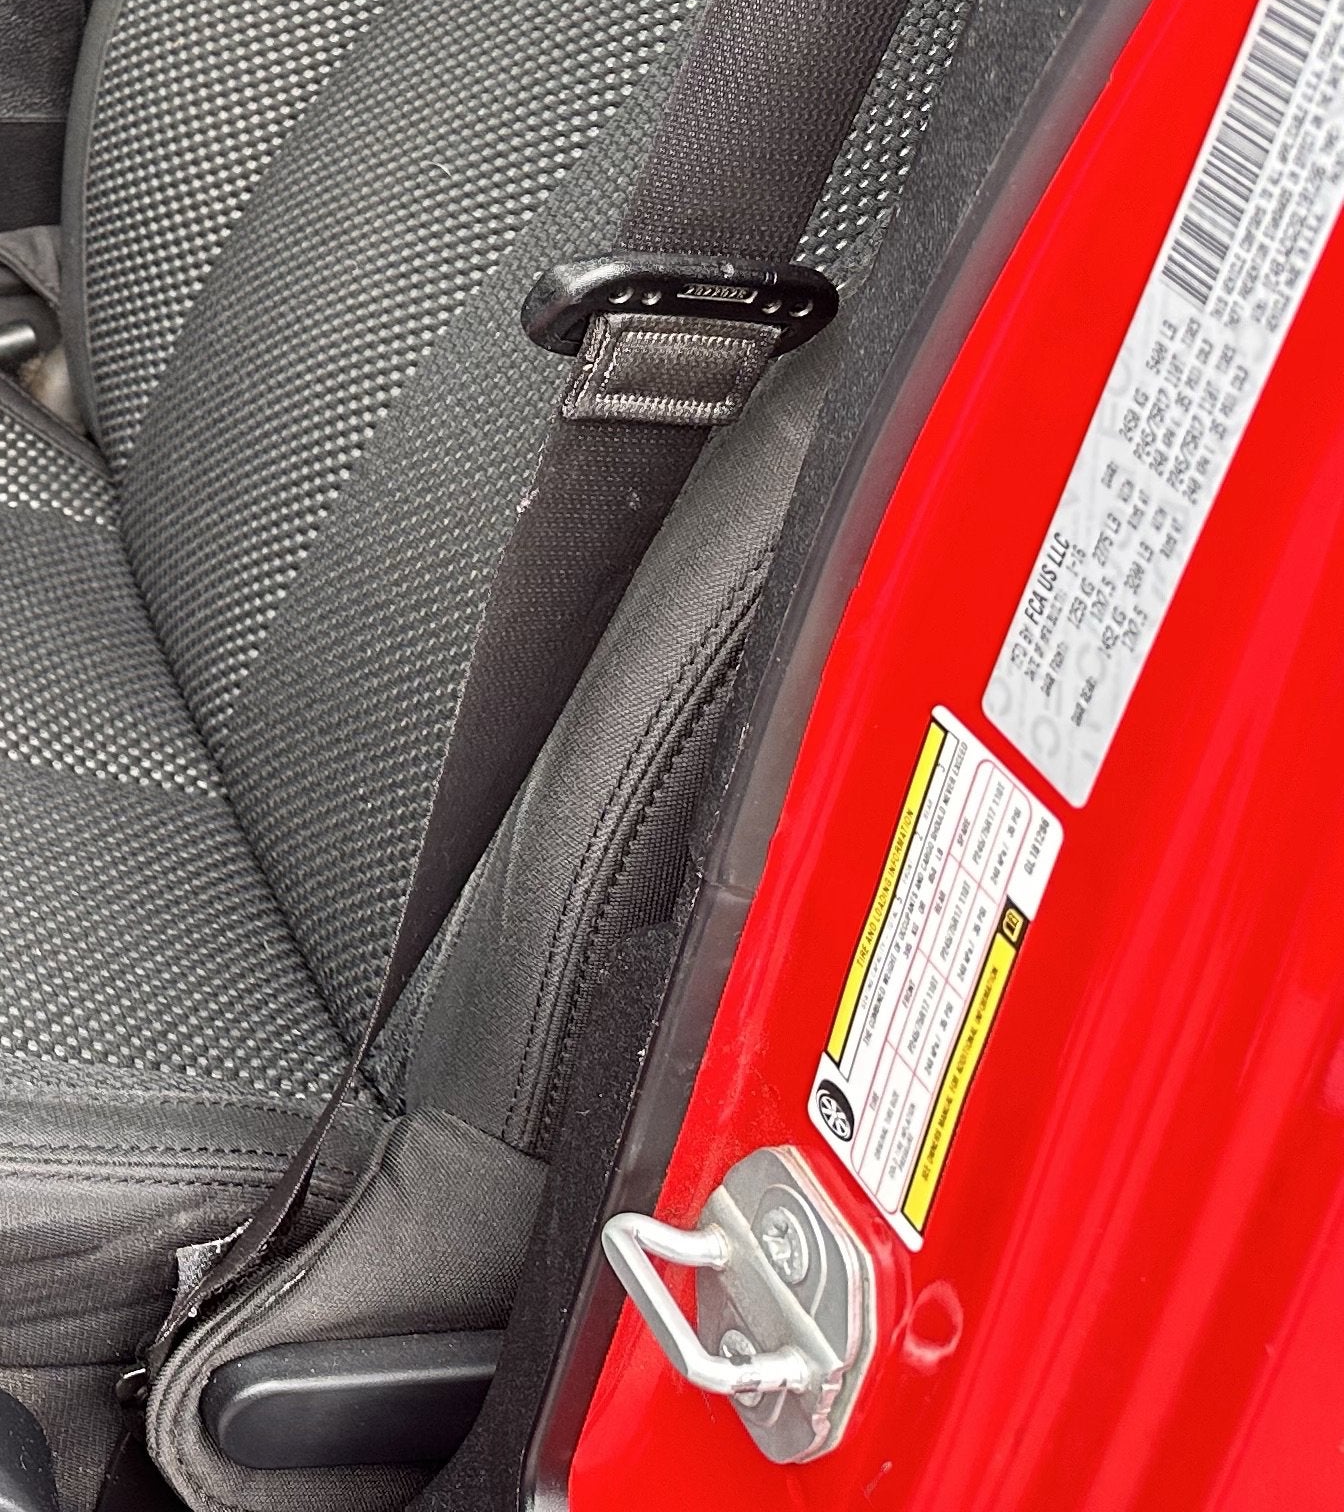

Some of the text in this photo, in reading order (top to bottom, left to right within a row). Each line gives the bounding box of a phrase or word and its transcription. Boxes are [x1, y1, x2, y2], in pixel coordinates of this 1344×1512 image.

[1046, 529, 1070, 569] LLC
[1036, 561, 1058, 594] US
[1024, 586, 1048, 626] FCA
[956, 815, 970, 847] SPARE
[971, 805, 996, 865] P245/75R17
[856, 806, 913, 969] TIRE AND LOADING INFORMATION
[862, 740, 968, 1047] THE COMBINED WEIGHT OF OCCUPANTS AND CARGO SHOULD NEVER EXCEED
[933, 888, 946, 915] REAR
[939, 903, 963, 961] P245/75R17
[901, 978, 915, 1009] FRONT
[937, 1093, 952, 1128] MANUAL
[948, 1073, 959, 1094] FOR
